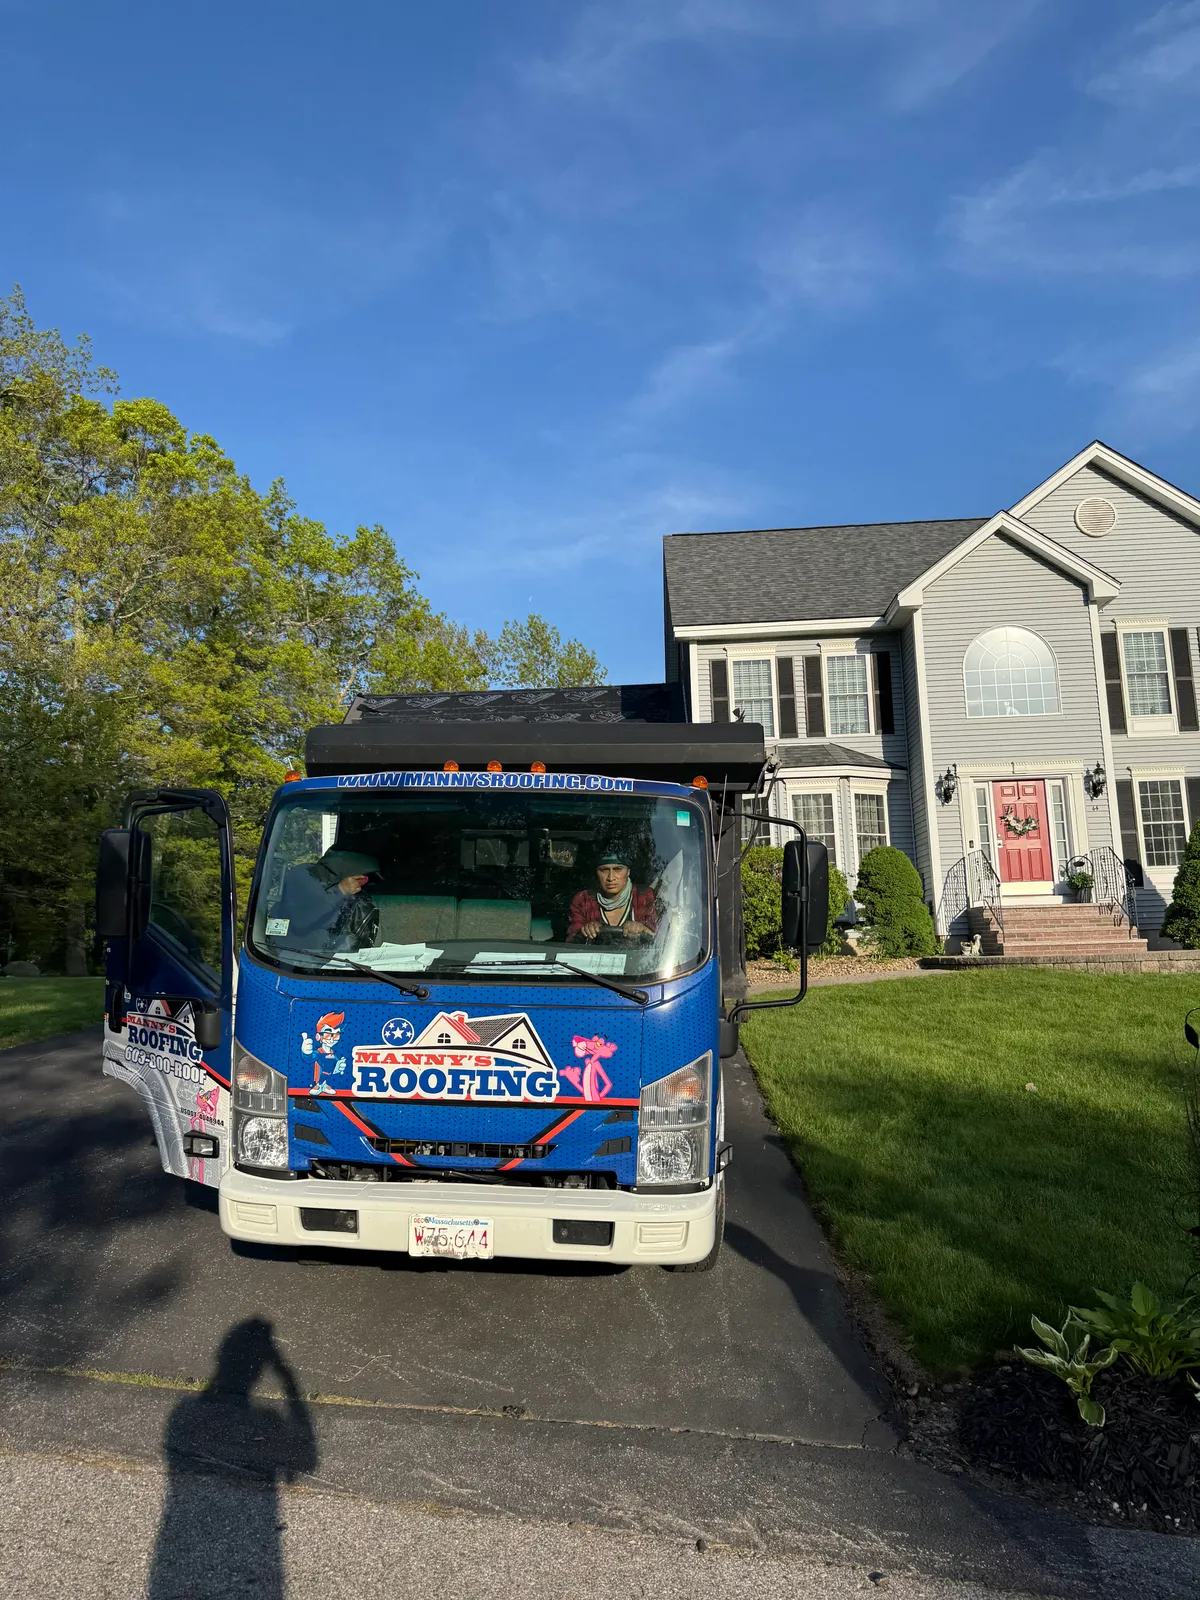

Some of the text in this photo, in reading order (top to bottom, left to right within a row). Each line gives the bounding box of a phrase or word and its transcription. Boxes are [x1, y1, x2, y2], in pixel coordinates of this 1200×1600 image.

[127, 1015, 175, 1033] MANNY'S
[128, 1025, 203, 1062] ROOFING
[125, 1045, 207, 1085] 603-800-ROOF
[355, 1052, 492, 1067] MANNY'S
[356, 1067, 556, 1098] ROOFING
